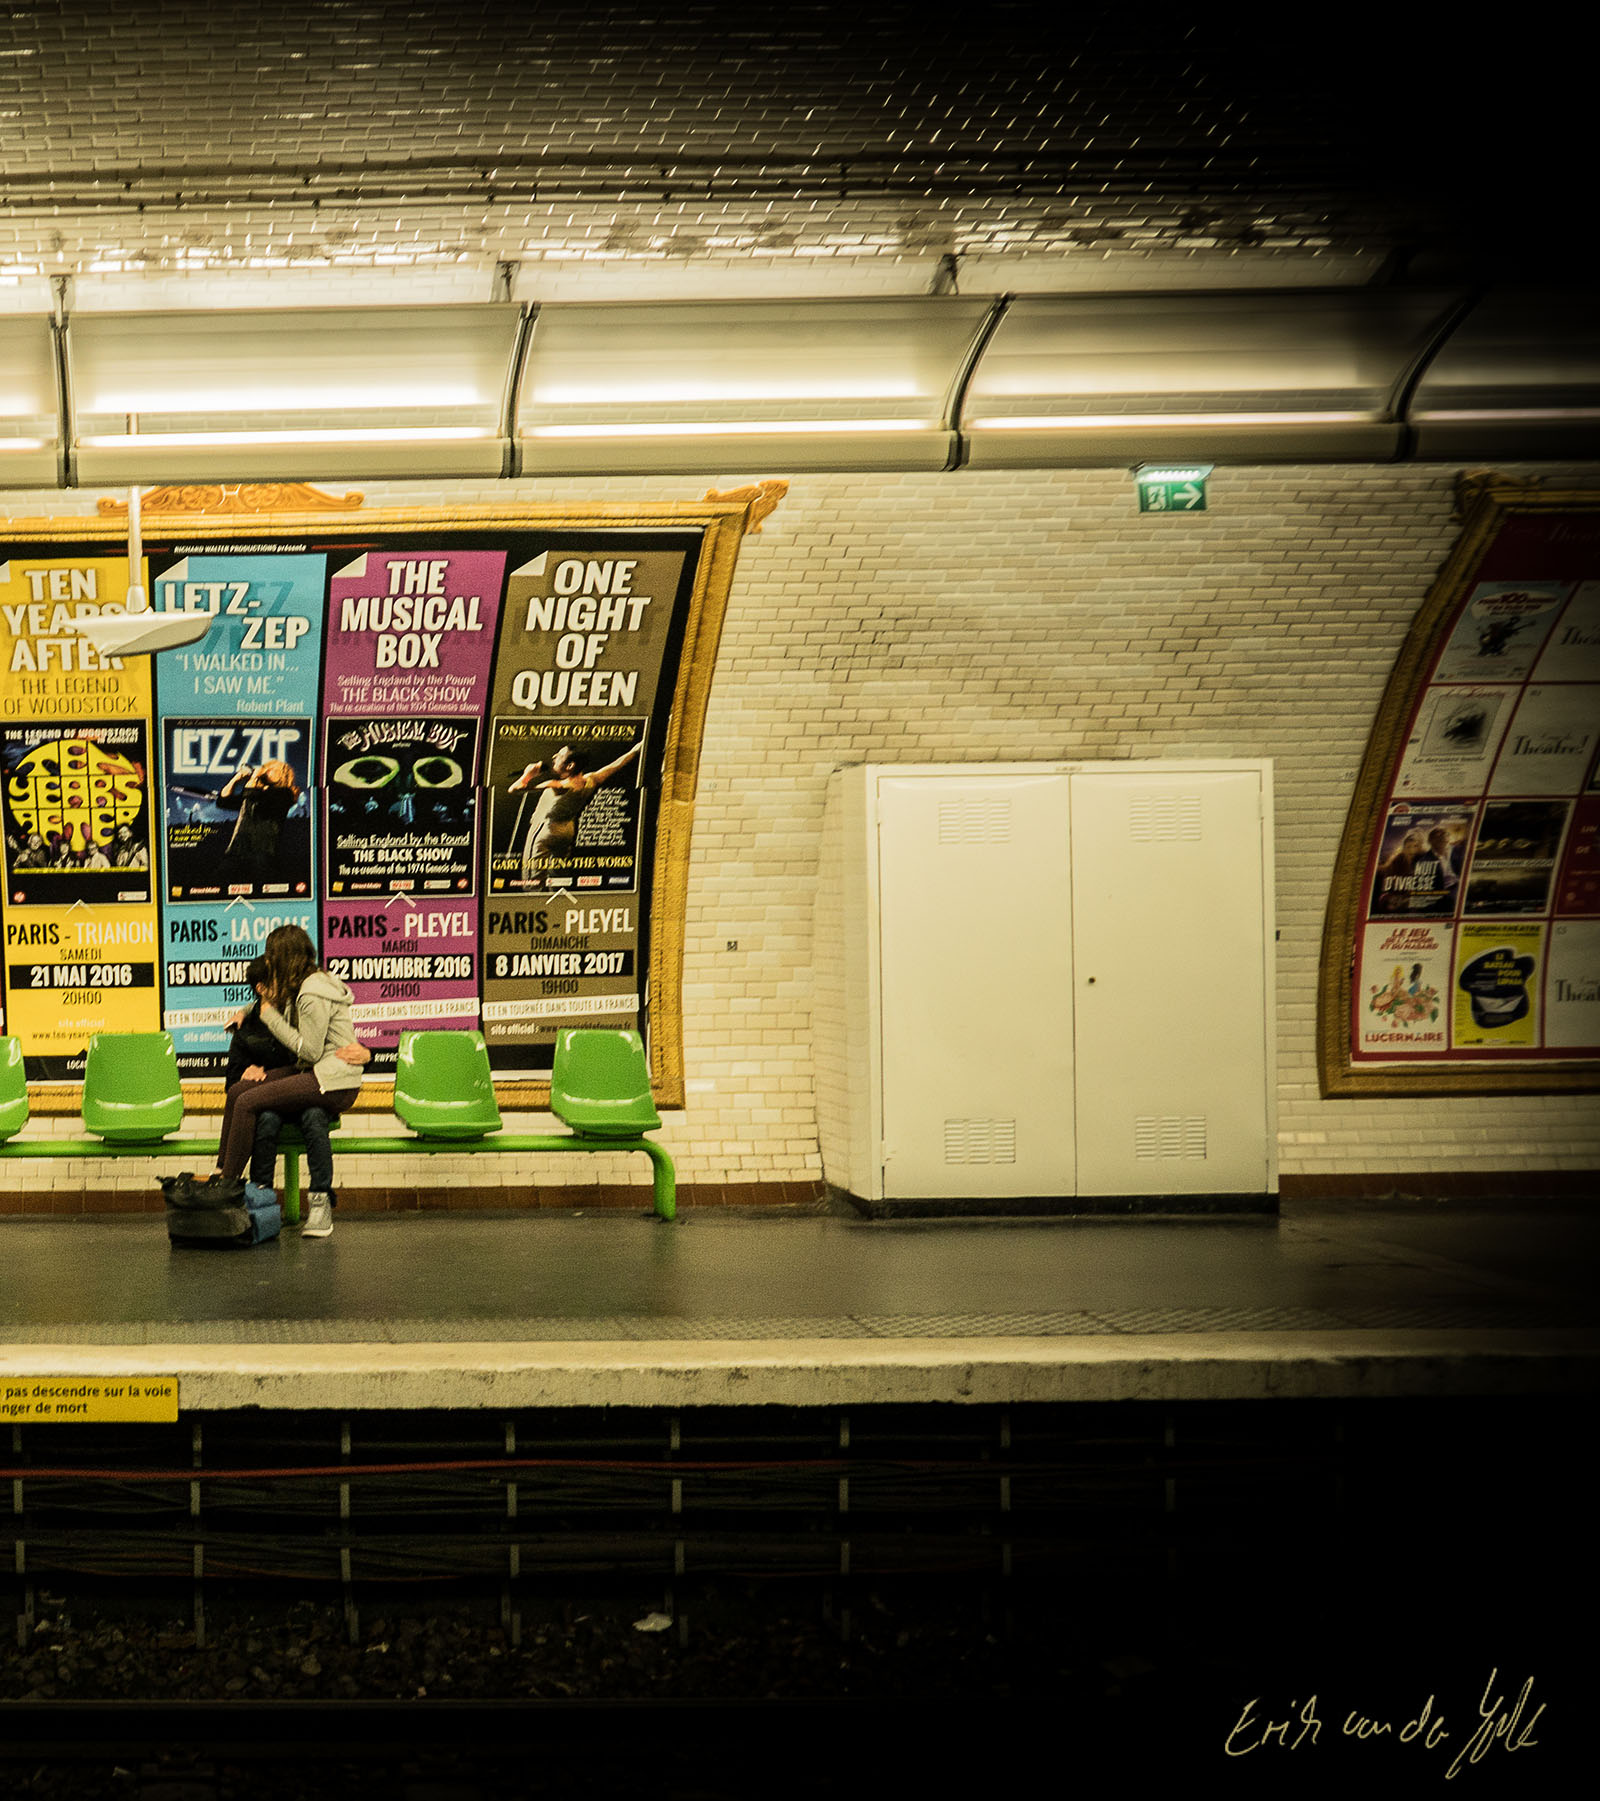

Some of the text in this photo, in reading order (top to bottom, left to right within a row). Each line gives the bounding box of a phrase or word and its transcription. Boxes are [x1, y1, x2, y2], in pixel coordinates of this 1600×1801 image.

[205, 545, 228, 553] WALTER
[229, 544, 276, 552] PRODUCTIONS
[25, 568, 97, 601] TEN
[387, 560, 448, 595] THE
[554, 560, 638, 595] ONE
[165, 582, 261, 615] LETZ-
[341, 597, 483, 632] MUSICAL
[525, 597, 652, 631] NIGHT
[240, 617, 310, 649] ZEP
[376, 633, 443, 669] BOX
[555, 633, 609, 669] OF
[193, 653, 299, 672] WALKED IN...
[20, 677, 119, 695] THE LEGEND
[204, 676, 243, 694] SAW
[337, 674, 476, 687] Selling England by the Pound
[341, 686, 471, 703] THE BLACK SHOW
[511, 670, 638, 711] QUEEN
[4, 696, 138, 715] OF WOODSTOCK
[236, 699, 304, 713] Robert Plant
[330, 703, 343, 713] The
[460, 703, 480, 712] show
[5, 728, 138, 740] THE LEGEND OF WOODSTOCK
[499, 724, 636, 738] ONE NIGHT OF QUEEN
[337, 831, 470, 849] Selling England by the Pound
[353, 848, 453, 862] THE BLACK SHOW
[492, 859, 520, 871] GARY
[571, 857, 596, 868] THE
[597, 856, 633, 868] WORKS
[339, 864, 350, 875] The
[395, 864, 406, 874] the
[407, 863, 424, 874] 1974
[450, 863, 467, 872] show
[328, 912, 474, 938] PARIS PLEYEL
[488, 908, 634, 934] PARIS PLEYEL
[7, 922, 154, 945] PARIS TRIANON
[171, 918, 250, 943] PARIS LA
[1408, 928, 1431, 937] JEU
[222, 944, 258, 957] MARDI
[382, 940, 418, 953] MARDI
[531, 935, 590, 950] DIMANCHE
[60, 948, 102, 961] SAMEDI
[329, 955, 471, 980] 22 NOVEMBRE 2016
[495, 952, 625, 976] 8 JANVIER 2017
[30, 964, 132, 987] 21 MAI 2016
[168, 963, 186, 985] 15
[380, 982, 420, 998] 20H00
[541, 979, 579, 994] 19H00
[62, 991, 102, 1005] 20H00
[386, 1005, 408, 1017] DANS
[409, 1004, 433, 1016] TOUTE
[434, 1004, 444, 1015] LA
[445, 1002, 474, 1014] FRANCE
[487, 998, 635, 1017] ET EN TOURNÉE DANS TOUTE LA FRANCE
[169, 1013, 177, 1025] ET
[180, 1013, 190, 1024] EN
[192, 1010, 225, 1024] TOURNÉE
[491, 1024, 506, 1035] site
[507, 1022, 535, 1034] officiel
[5, 1387, 28, 1400] pas
[32, 1385, 99, 1397] descendre
[104, 1388, 123, 1397] sur
[128, 1385, 140, 1397] la
[145, 1384, 172, 1397] voie
[35, 1402, 51, 1414] de
[55, 1402, 88, 1414] mort
